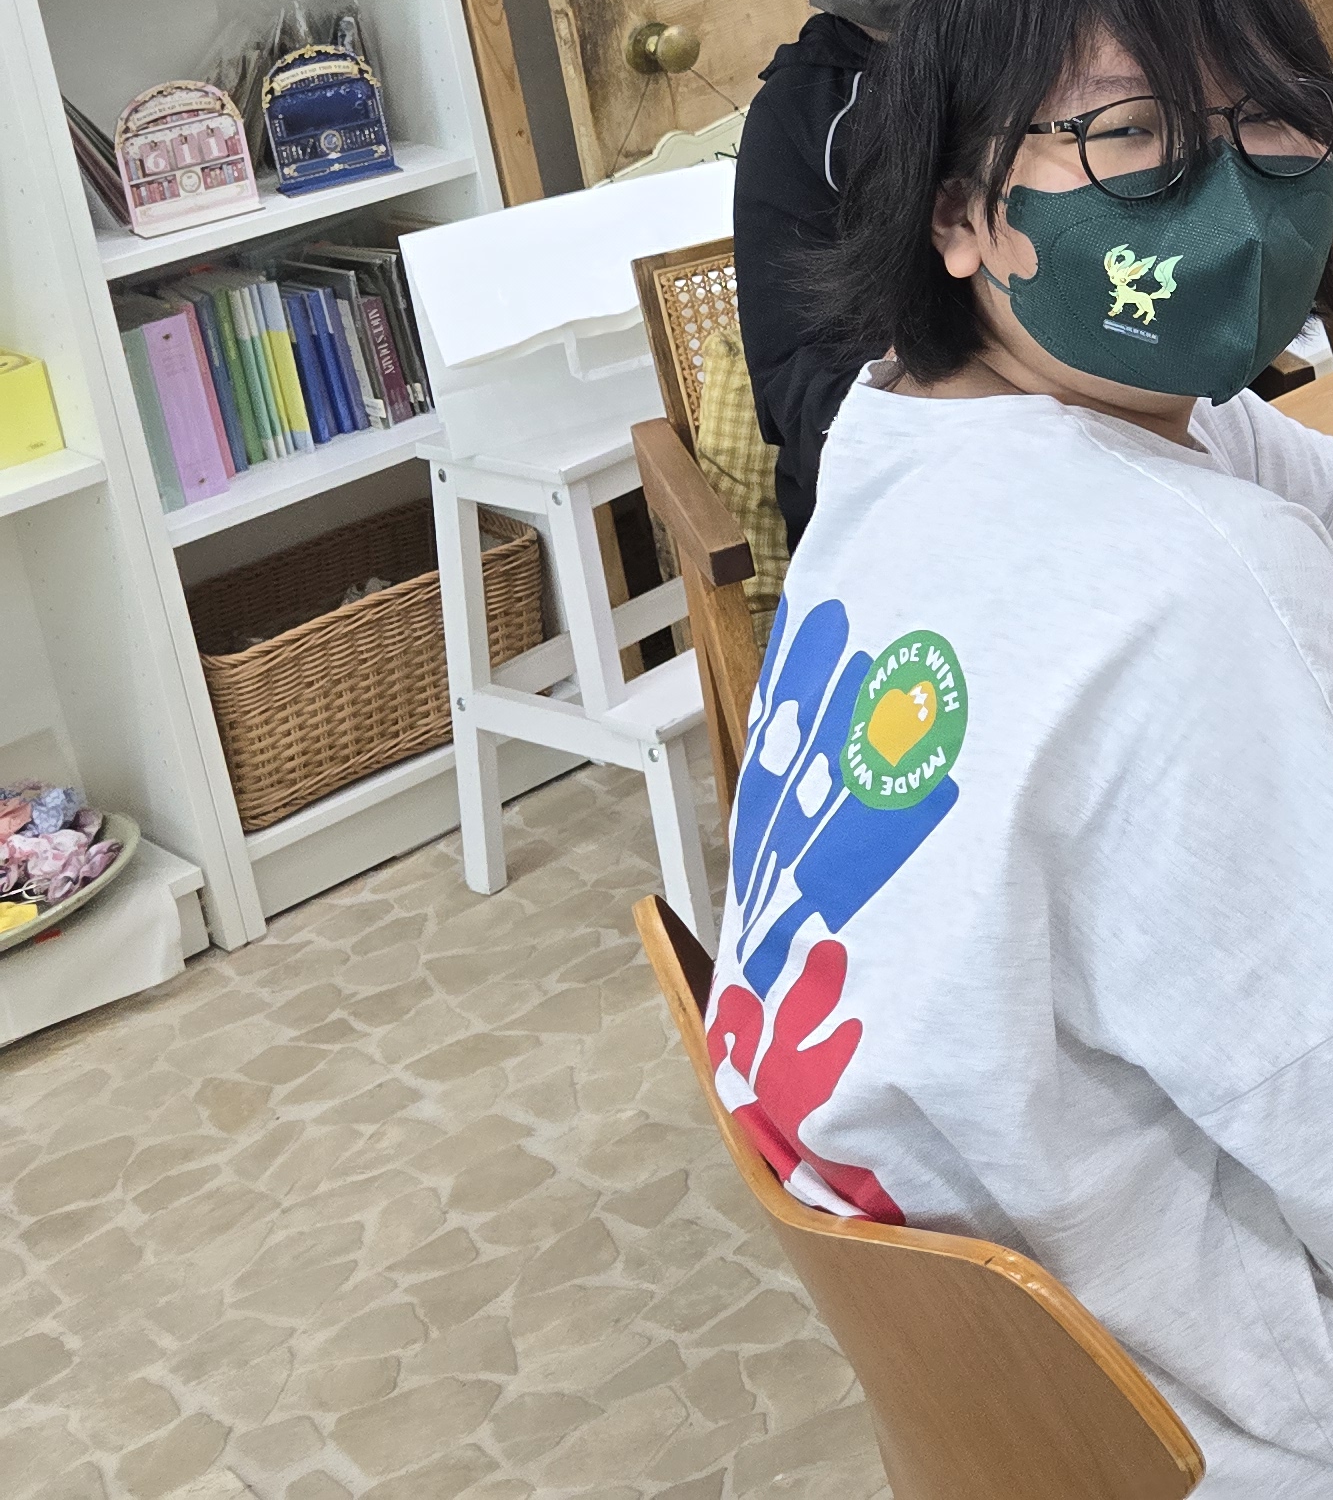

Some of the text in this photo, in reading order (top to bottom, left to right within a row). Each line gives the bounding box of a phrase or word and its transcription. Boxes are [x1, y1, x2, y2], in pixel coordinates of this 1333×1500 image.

[868, 642, 960, 712] MADE WITH
[847, 721, 947, 796] MADE WITH
